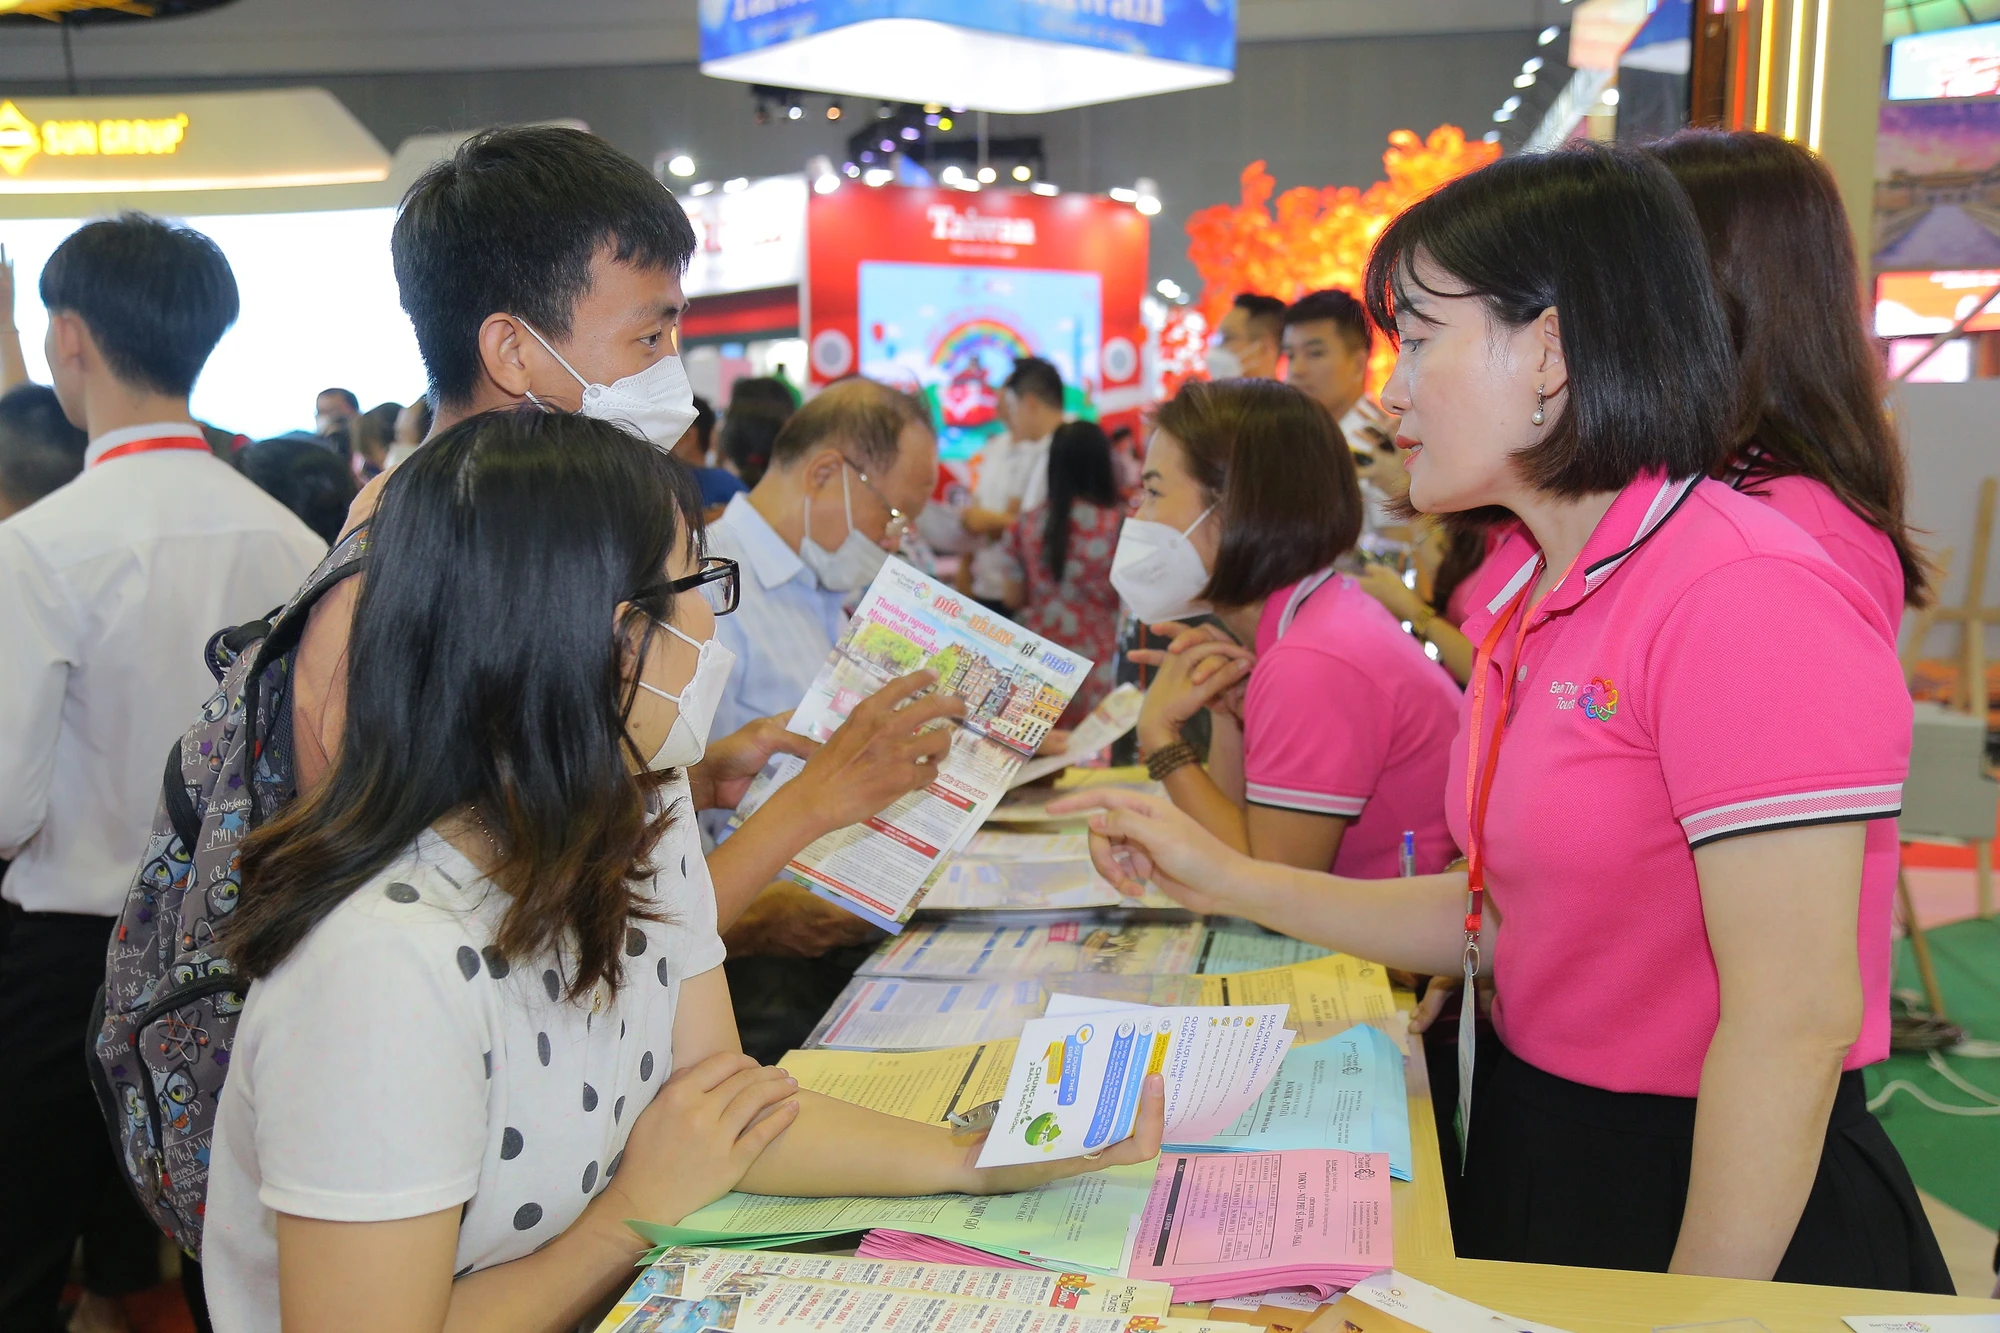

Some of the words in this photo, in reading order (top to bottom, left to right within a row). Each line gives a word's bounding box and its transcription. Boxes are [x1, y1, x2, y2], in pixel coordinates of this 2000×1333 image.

[41, 120, 98, 155] SUN
[99, 118, 184, 155] GROUP
[926, 204, 1036, 245] Taiwan
[932, 592, 965, 619] ĐỨC
[967, 610, 992, 633] HÀ
[986, 623, 1015, 646] LAN
[1039, 647, 1078, 678] PHÁP
[1255, 1014, 1268, 1040] KHÁCH
[1247, 1042, 1259, 1064] HÀNG
[1027, 1066, 1042, 1098] CHUNG
[1175, 1059, 1188, 1082] DÀNH
[1170, 1083, 1181, 1100] CHO
[1242, 1079, 1253, 1094] CHO
[1022, 1099, 1032, 1115] TAY
[1106, 1292, 1123, 1313] Tourist
[1117, 1285, 1137, 1315] BenThanh
